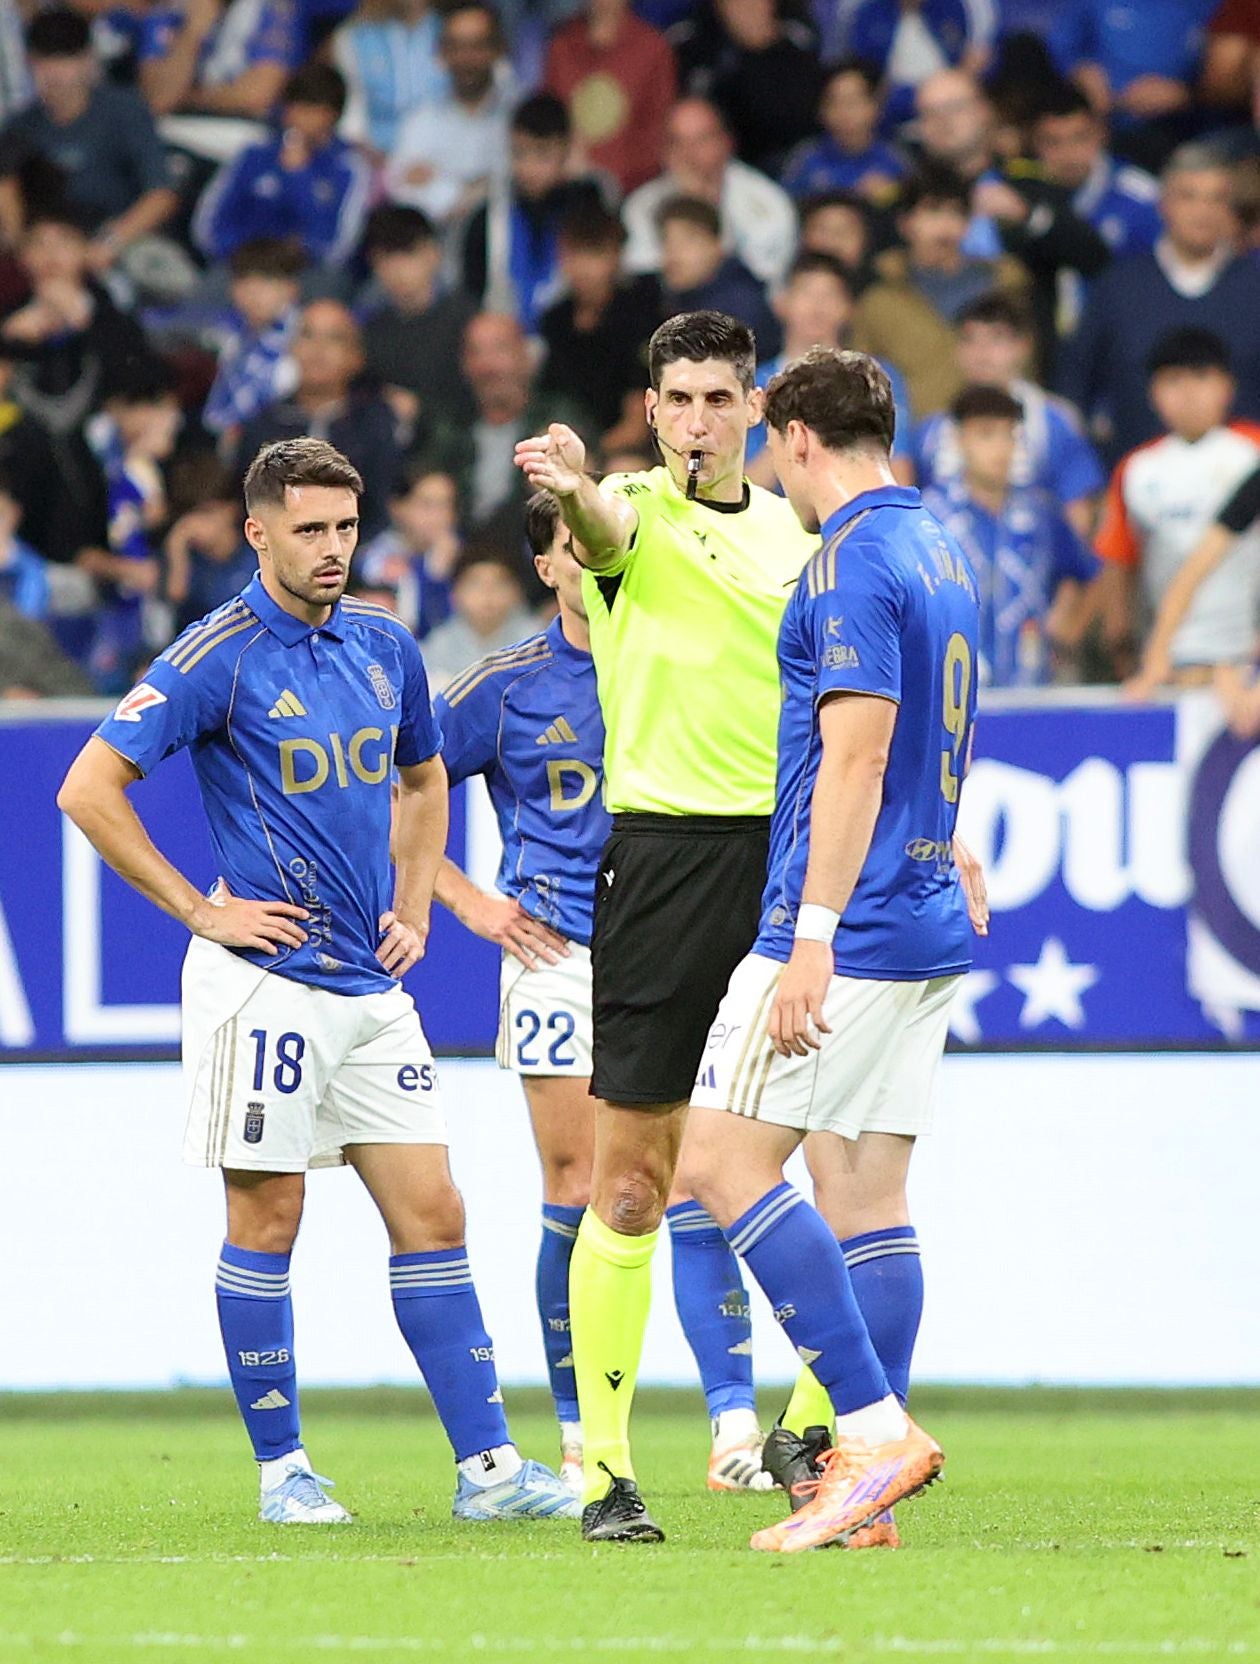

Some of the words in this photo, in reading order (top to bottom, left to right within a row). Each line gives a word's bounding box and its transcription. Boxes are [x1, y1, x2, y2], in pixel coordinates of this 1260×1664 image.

[940, 631, 972, 804] 9
[249, 1029, 305, 1094] 18
[515, 1009, 576, 1067] 22
[238, 1348, 290, 1367] 1926
